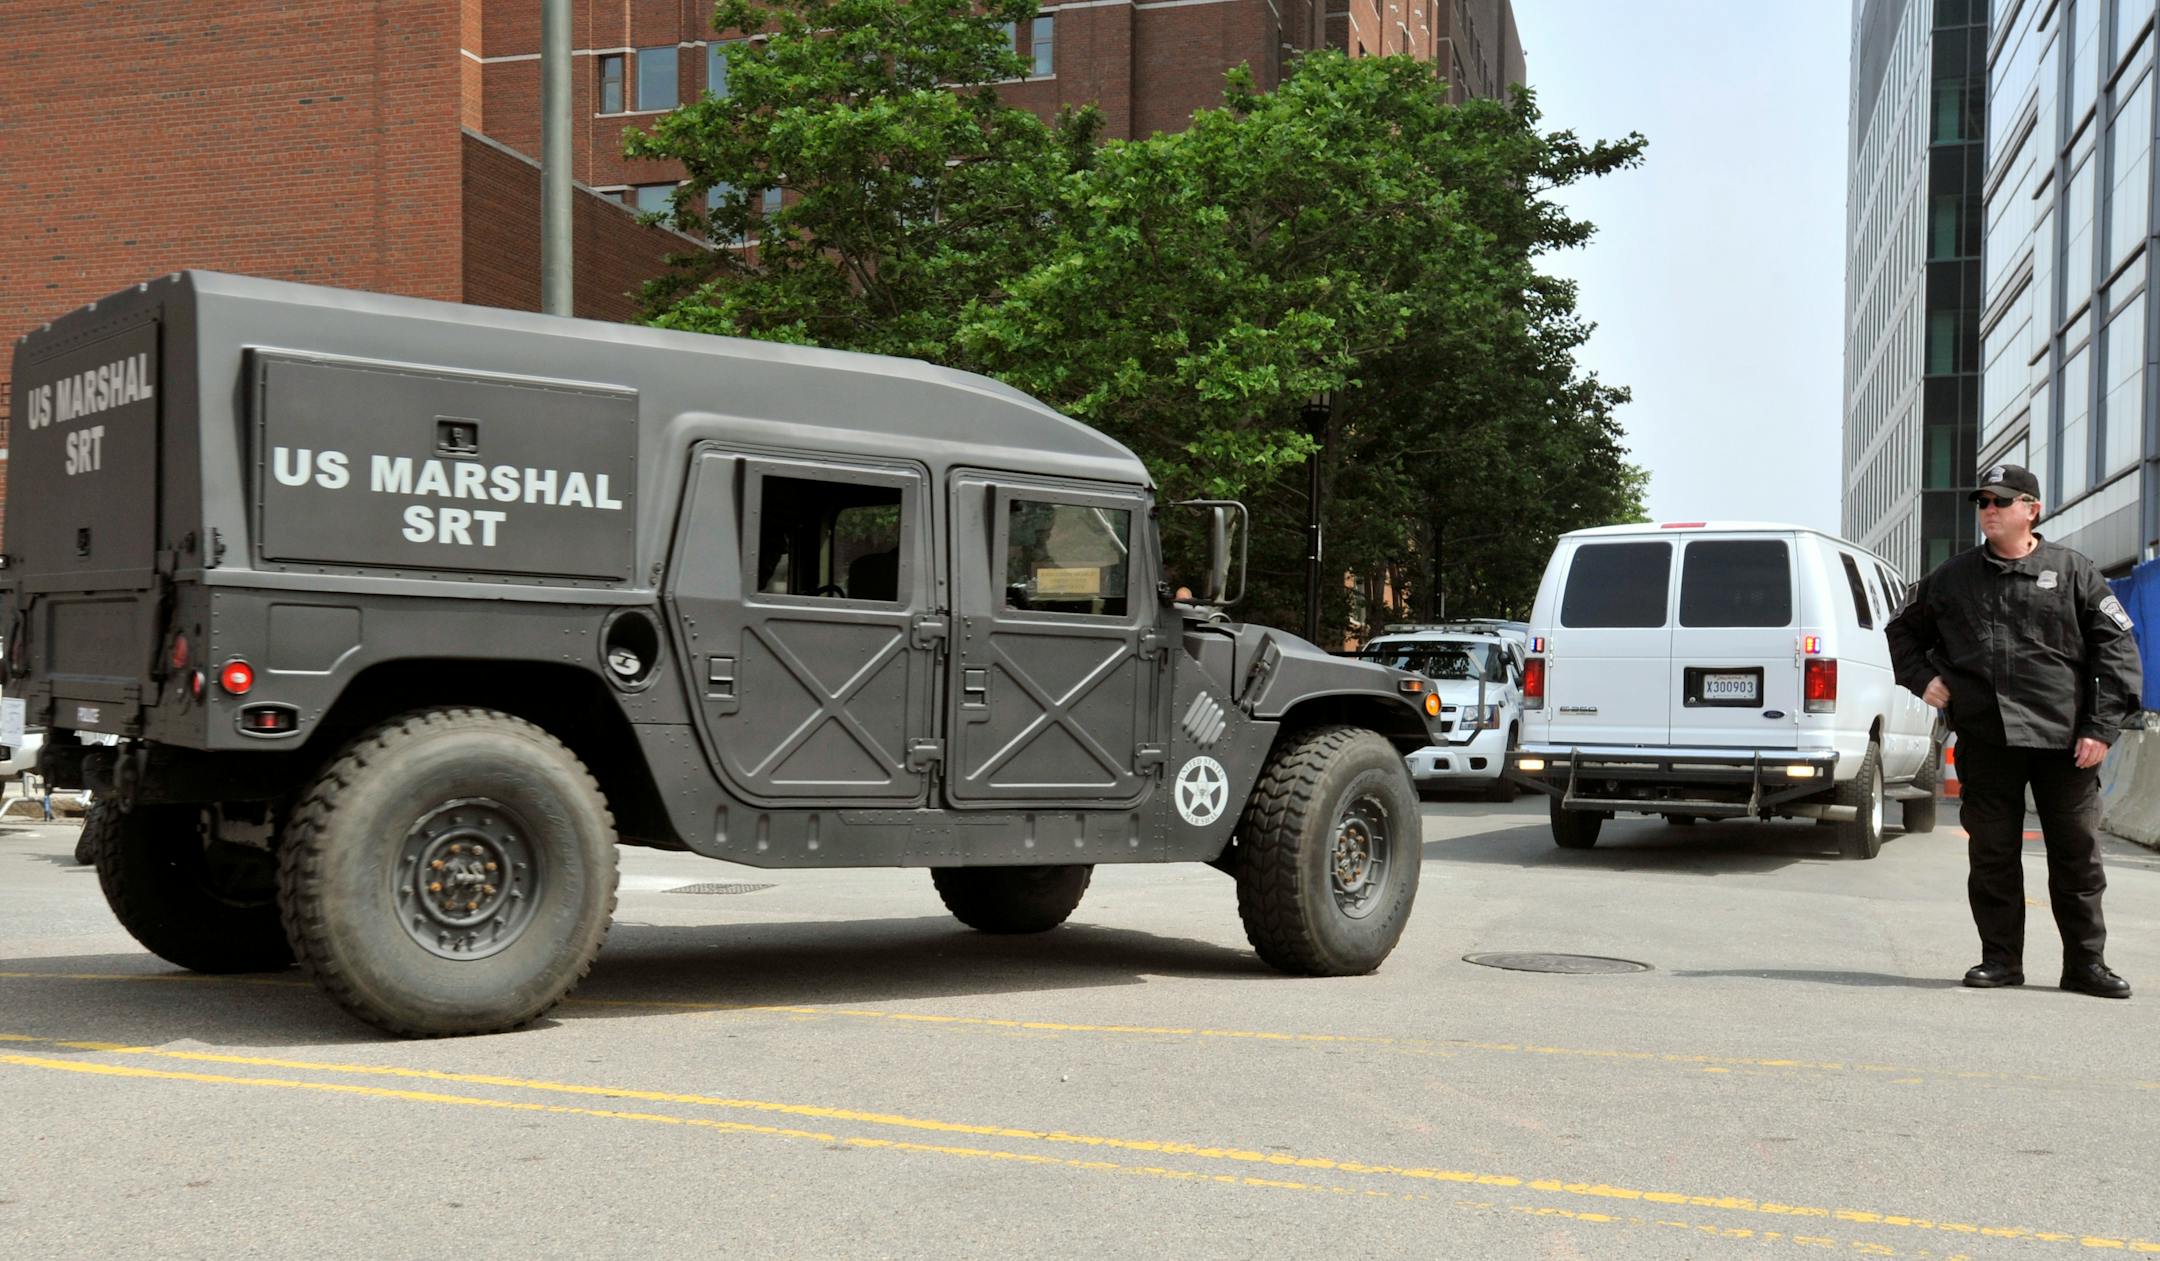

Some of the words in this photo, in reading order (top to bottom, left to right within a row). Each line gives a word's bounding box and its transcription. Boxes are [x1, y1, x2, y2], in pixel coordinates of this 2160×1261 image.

[28, 384, 52, 430] US
[56, 352, 153, 423] MARSHAL
[65, 425, 105, 476] SRT
[273, 446, 350, 490] US
[370, 454, 623, 510] MARSHAL
[402, 505, 507, 547] SRT
[1706, 680, 1754, 693] X300903
[1179, 758, 1203, 781] UNITED
[1203, 758, 1225, 780] STATES
[1185, 811, 1218, 825] MARSHAL
